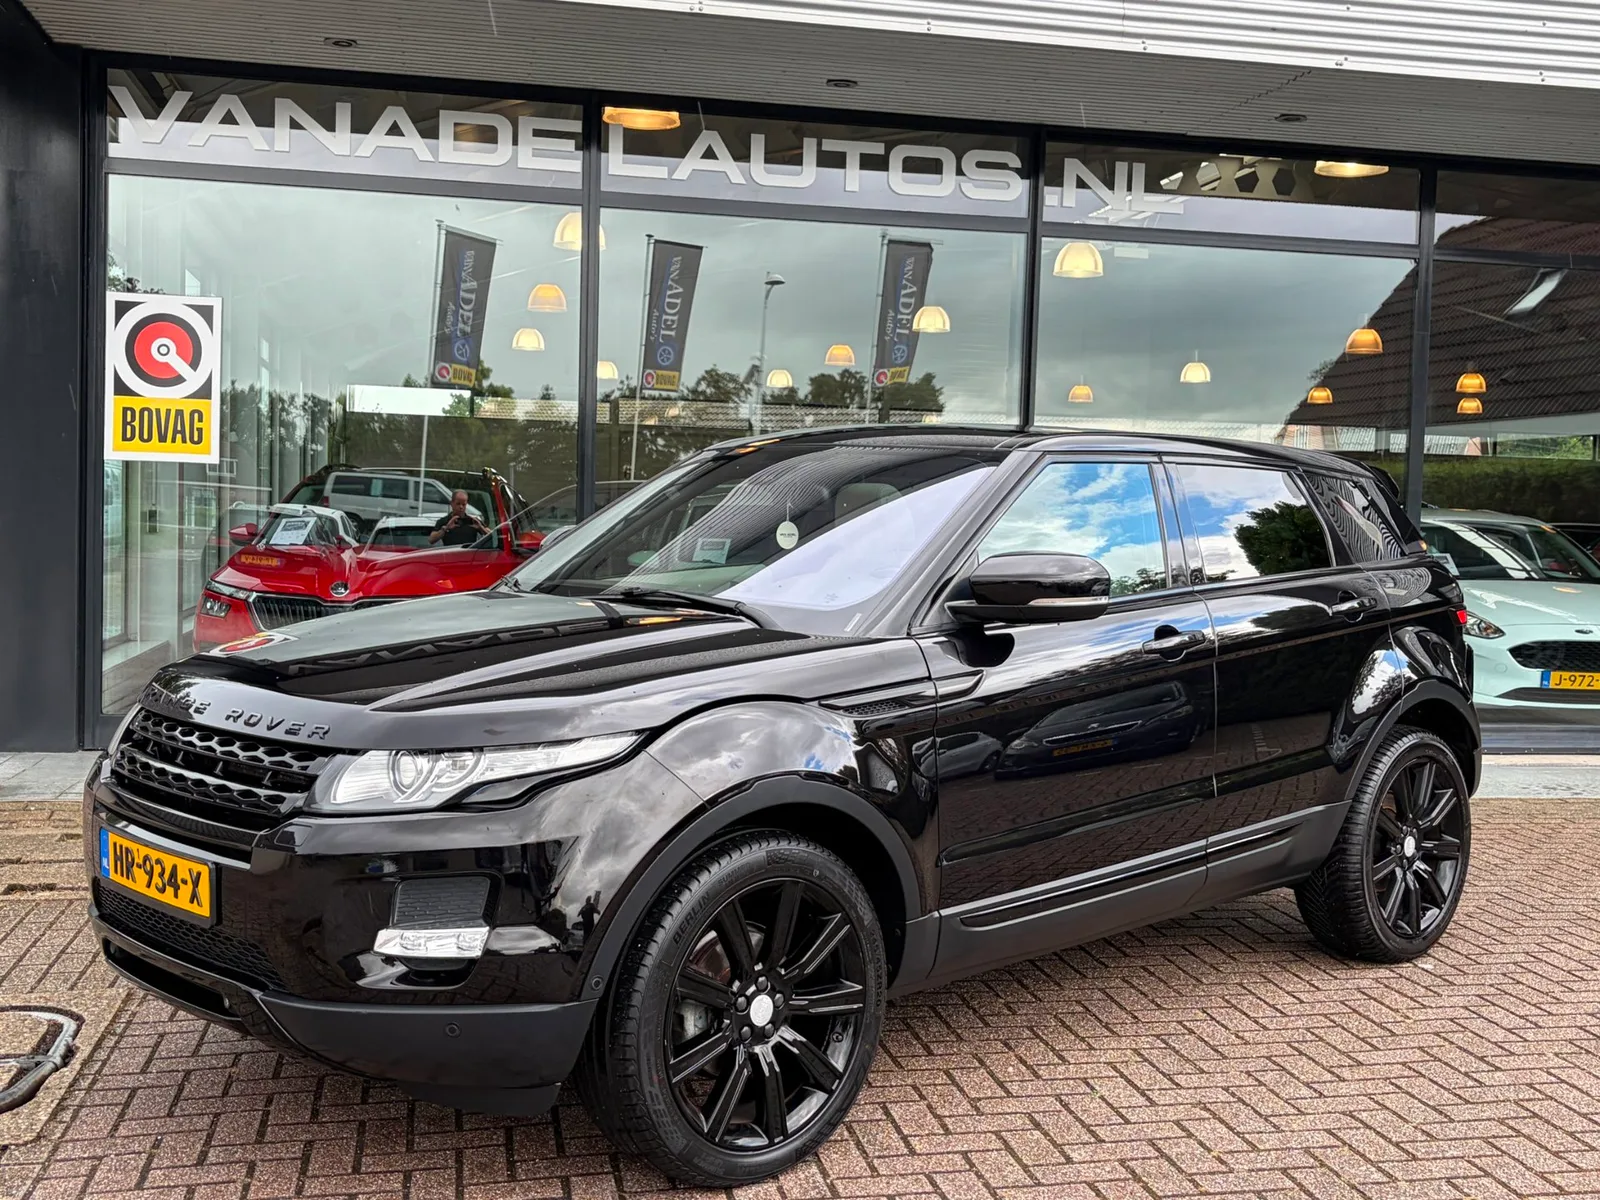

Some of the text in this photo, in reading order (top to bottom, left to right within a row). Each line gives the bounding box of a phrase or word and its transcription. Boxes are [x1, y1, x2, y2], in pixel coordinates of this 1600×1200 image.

[121, 406, 204, 445] BOVAG
[224, 707, 331, 740] ROVER
[113, 841, 203, 908] HR-934-X
[672, 892, 711, 945] BERLIN
